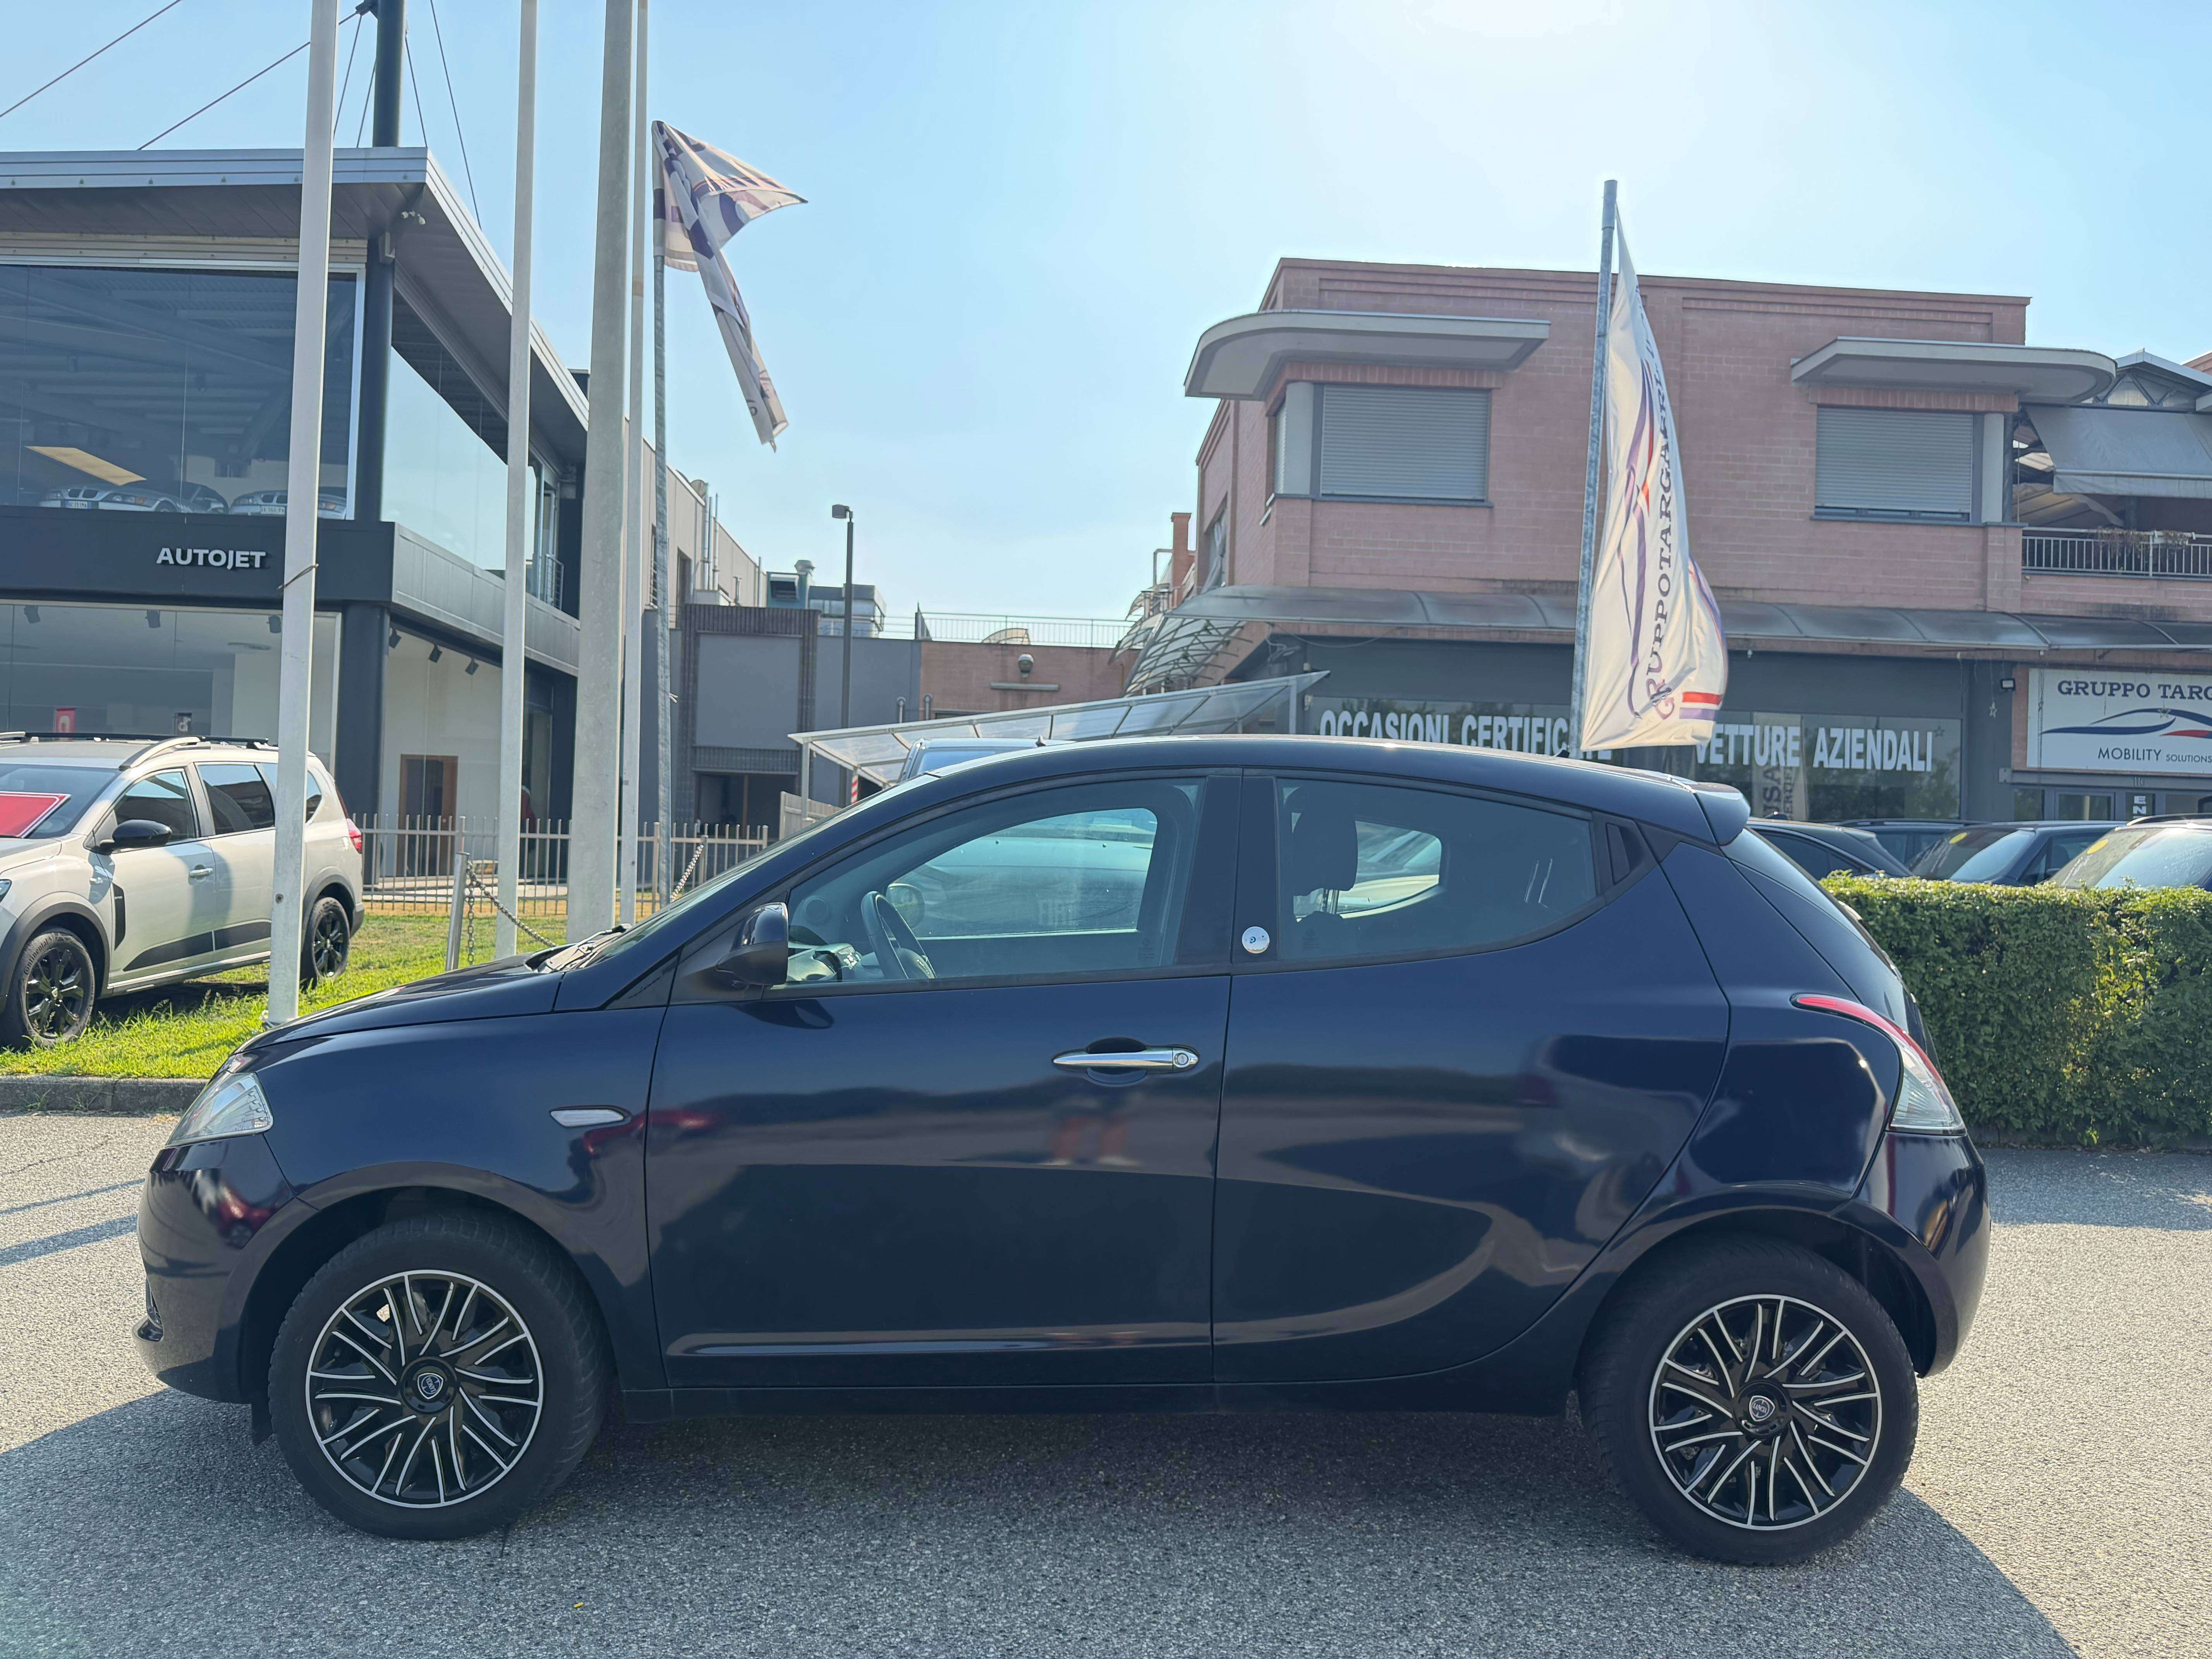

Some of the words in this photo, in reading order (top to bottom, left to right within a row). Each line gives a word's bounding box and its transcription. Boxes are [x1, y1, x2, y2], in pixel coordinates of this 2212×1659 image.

[156, 548, 266, 570] AUTOJET
[2057, 680, 2150, 698] GRUPPO
[1319, 709, 1449, 744] OCCASIONI
[1461, 714, 1612, 760] CERTIFIC
[1813, 727, 1933, 772] AZIENDALI
[2097, 747, 2162, 761] MOBILITY
[2166, 754, 2212, 763] SOLUTIONS
[23, 938, 49, 975] Continental
